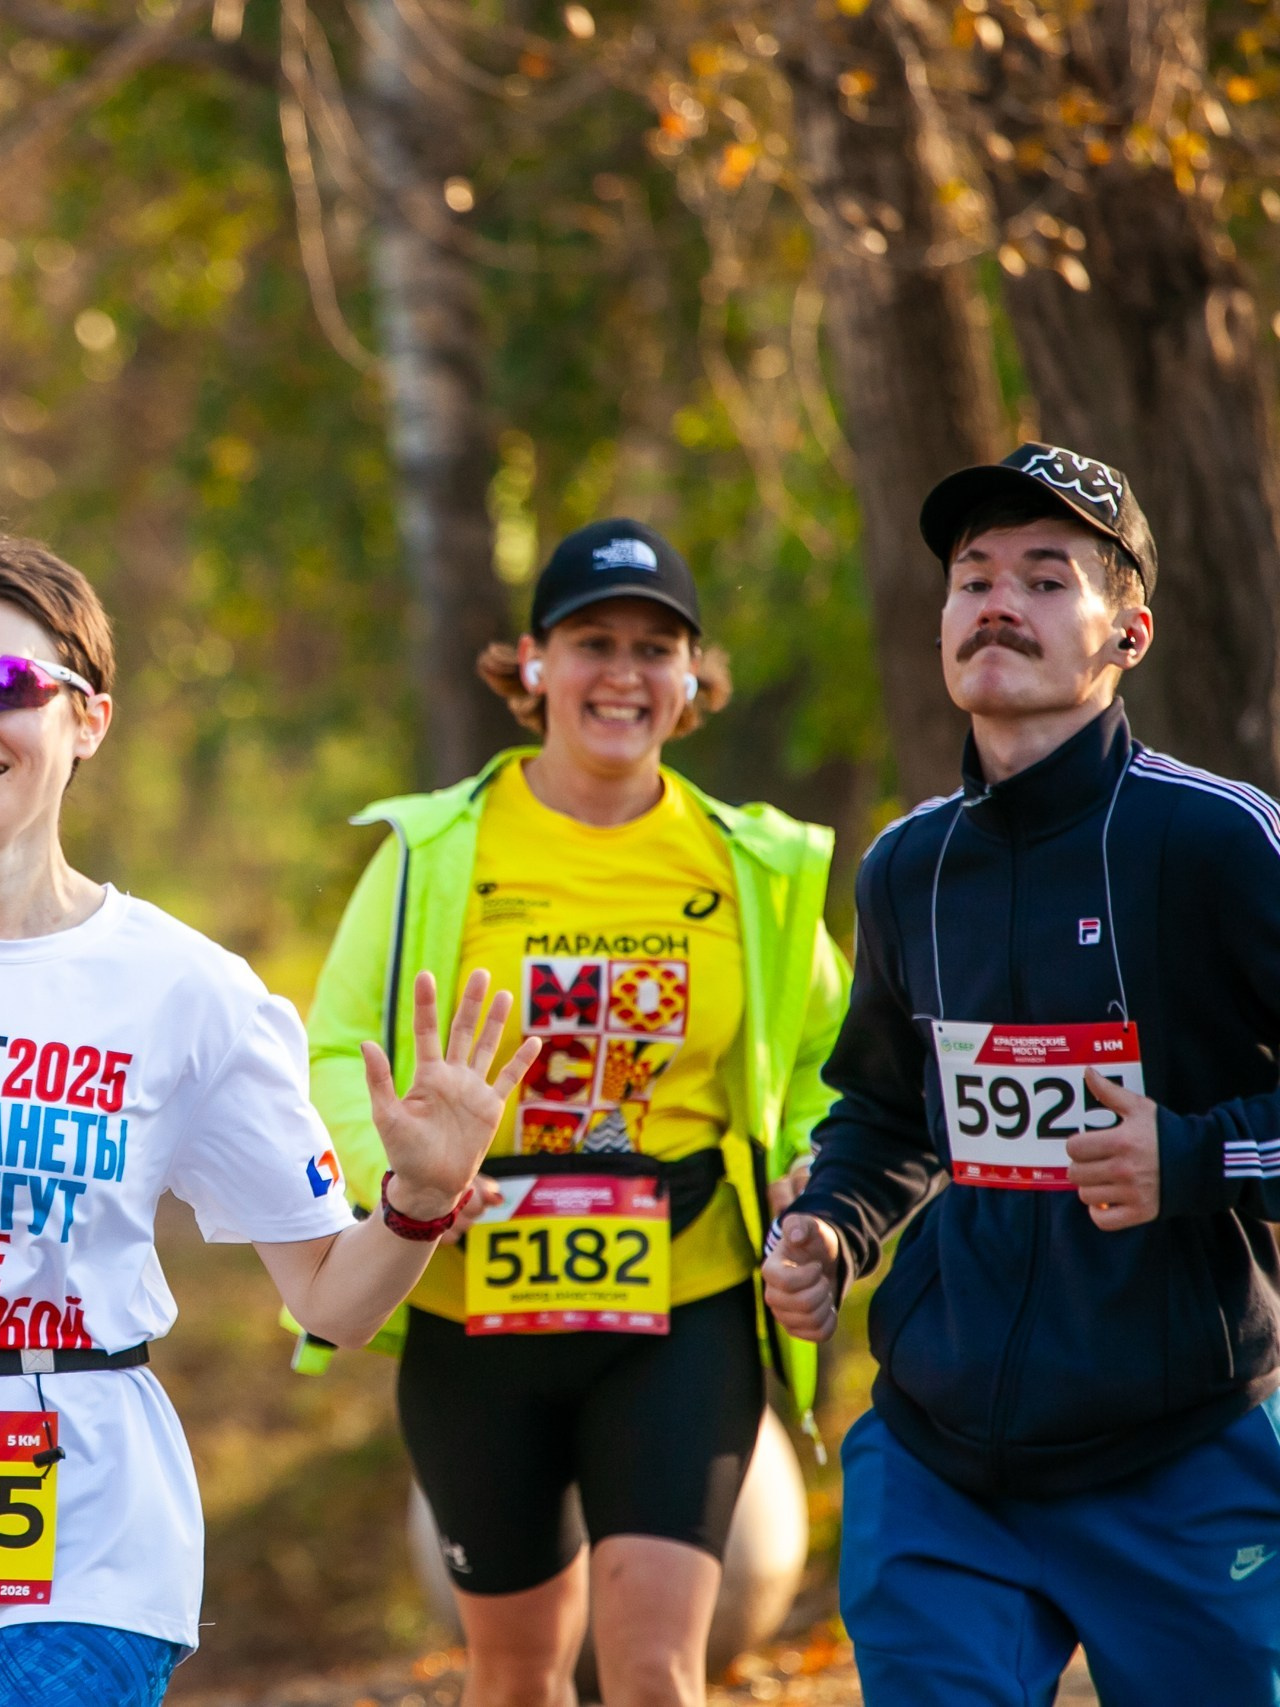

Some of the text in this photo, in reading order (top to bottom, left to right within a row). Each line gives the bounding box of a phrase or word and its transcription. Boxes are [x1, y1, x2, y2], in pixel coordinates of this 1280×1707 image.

[526, 934, 689, 955] МАРАФОН
[1094, 1041, 1102, 1051] 5
[486, 1228, 650, 1287] 5182
[7, 1435, 17, 1446] 5
[0, 1585, 30, 1596] 2026
